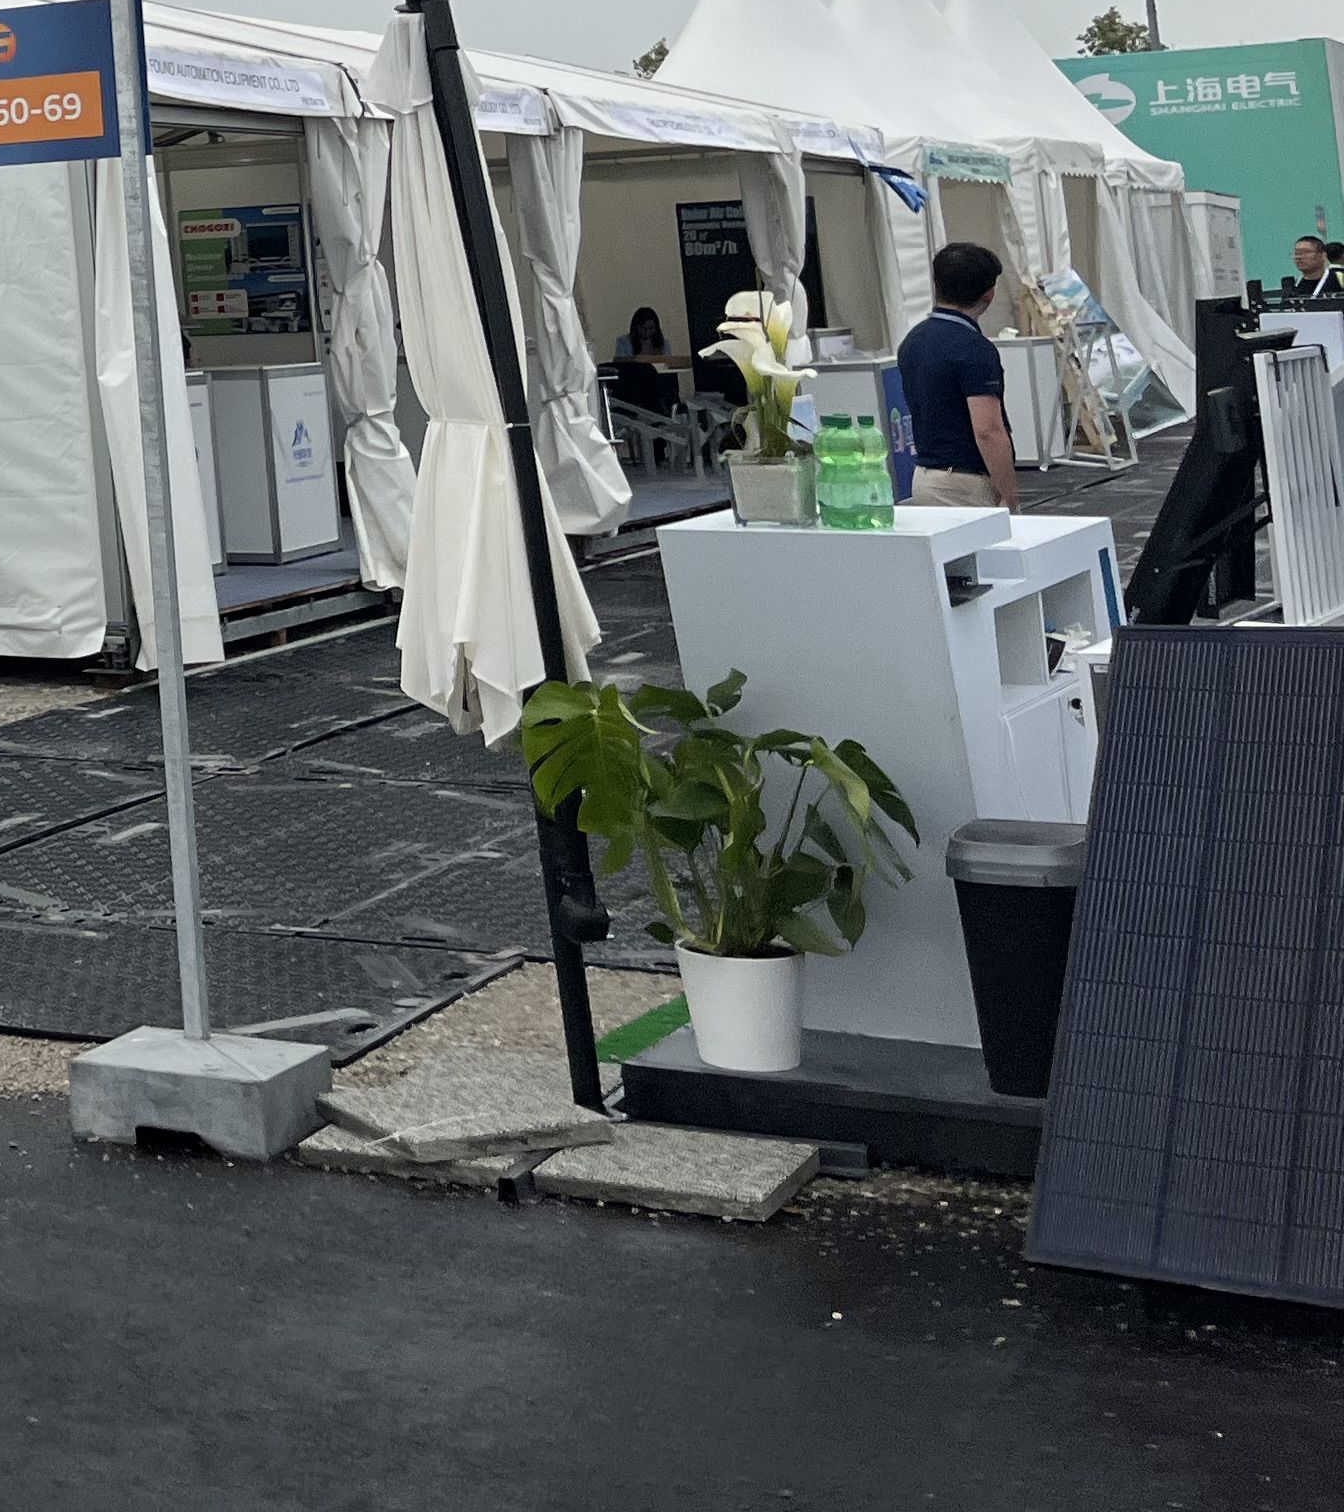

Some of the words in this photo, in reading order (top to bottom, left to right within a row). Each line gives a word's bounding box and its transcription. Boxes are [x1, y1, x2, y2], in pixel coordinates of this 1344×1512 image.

[149, 58, 176, 75] FOUND
[176, 63, 224, 83] AUTOMATION
[224, 70, 268, 90] EQUIPMENT
[1149, 71, 1300, 105] 上海电气
[1150, 103, 1227, 116] SHANGHAI
[1231, 97, 1303, 111] ELECTRIC
